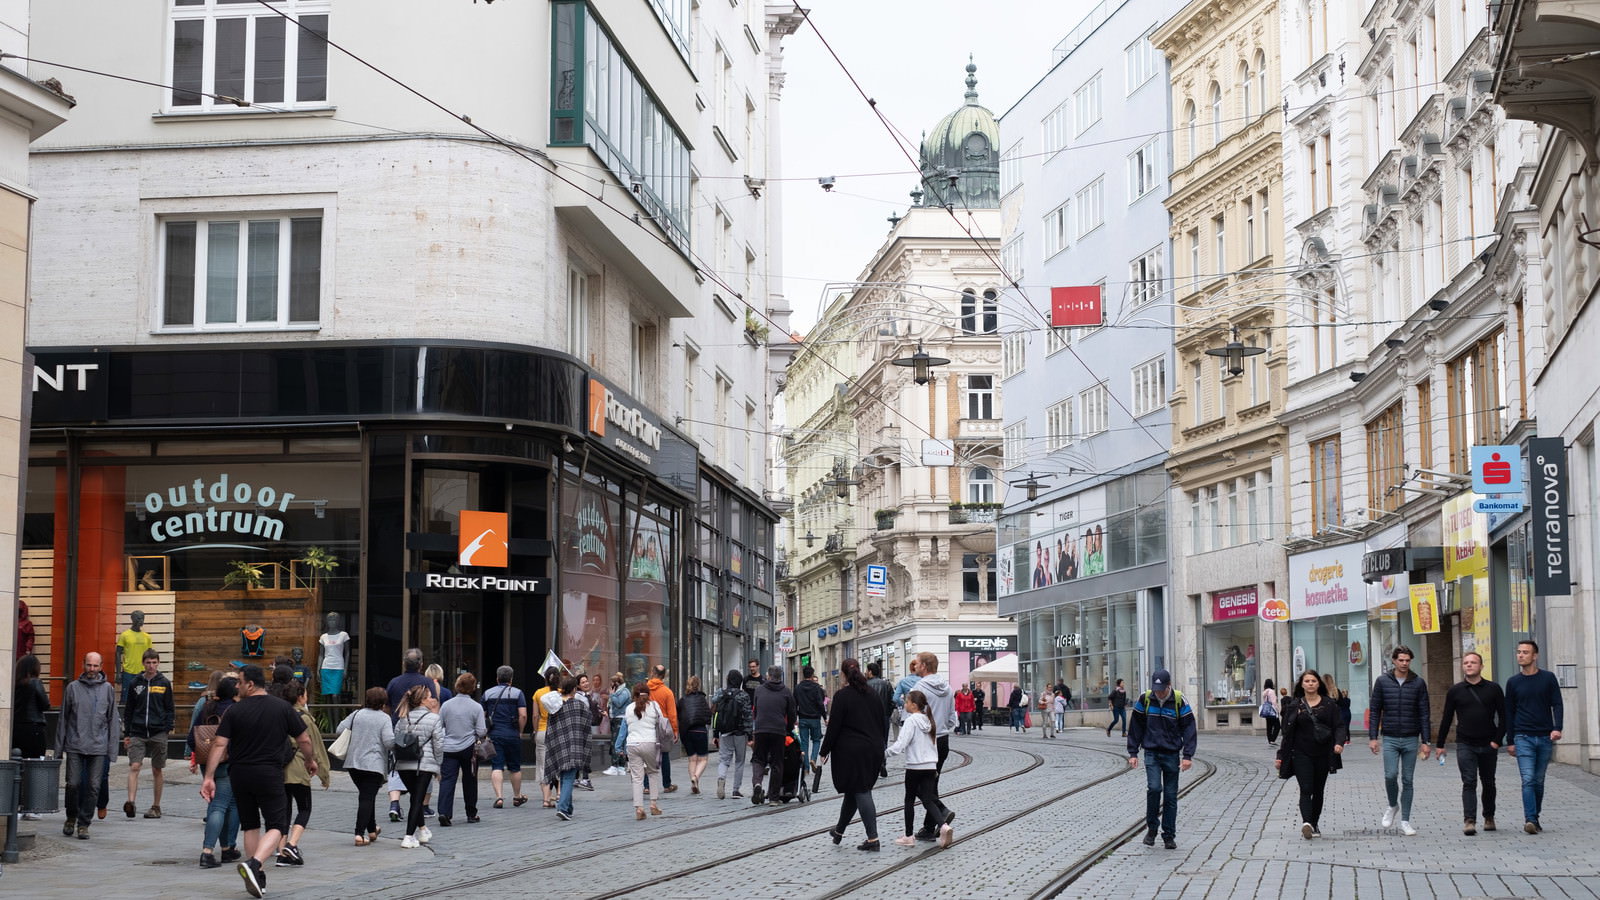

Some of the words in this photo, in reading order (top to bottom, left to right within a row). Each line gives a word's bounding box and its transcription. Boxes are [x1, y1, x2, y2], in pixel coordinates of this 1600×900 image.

[145, 473, 296, 513] outdoor
[1479, 502, 1519, 510] Bankomat
[150, 506, 284, 542] centrum
[577, 499, 608, 541] outdoor
[1059, 510, 1074, 521] TIGER
[1308, 560, 1344, 585] drogerie
[425, 573, 480, 589] ROCK
[481, 576, 539, 591] POINT
[1219, 592, 1256, 609] GENESIS
[1305, 583, 1349, 607] kosmetika
[1265, 607, 1287, 617] teta
[958, 637, 1008, 648] TEZENIS
[1055, 633, 1076, 647] TIGER
